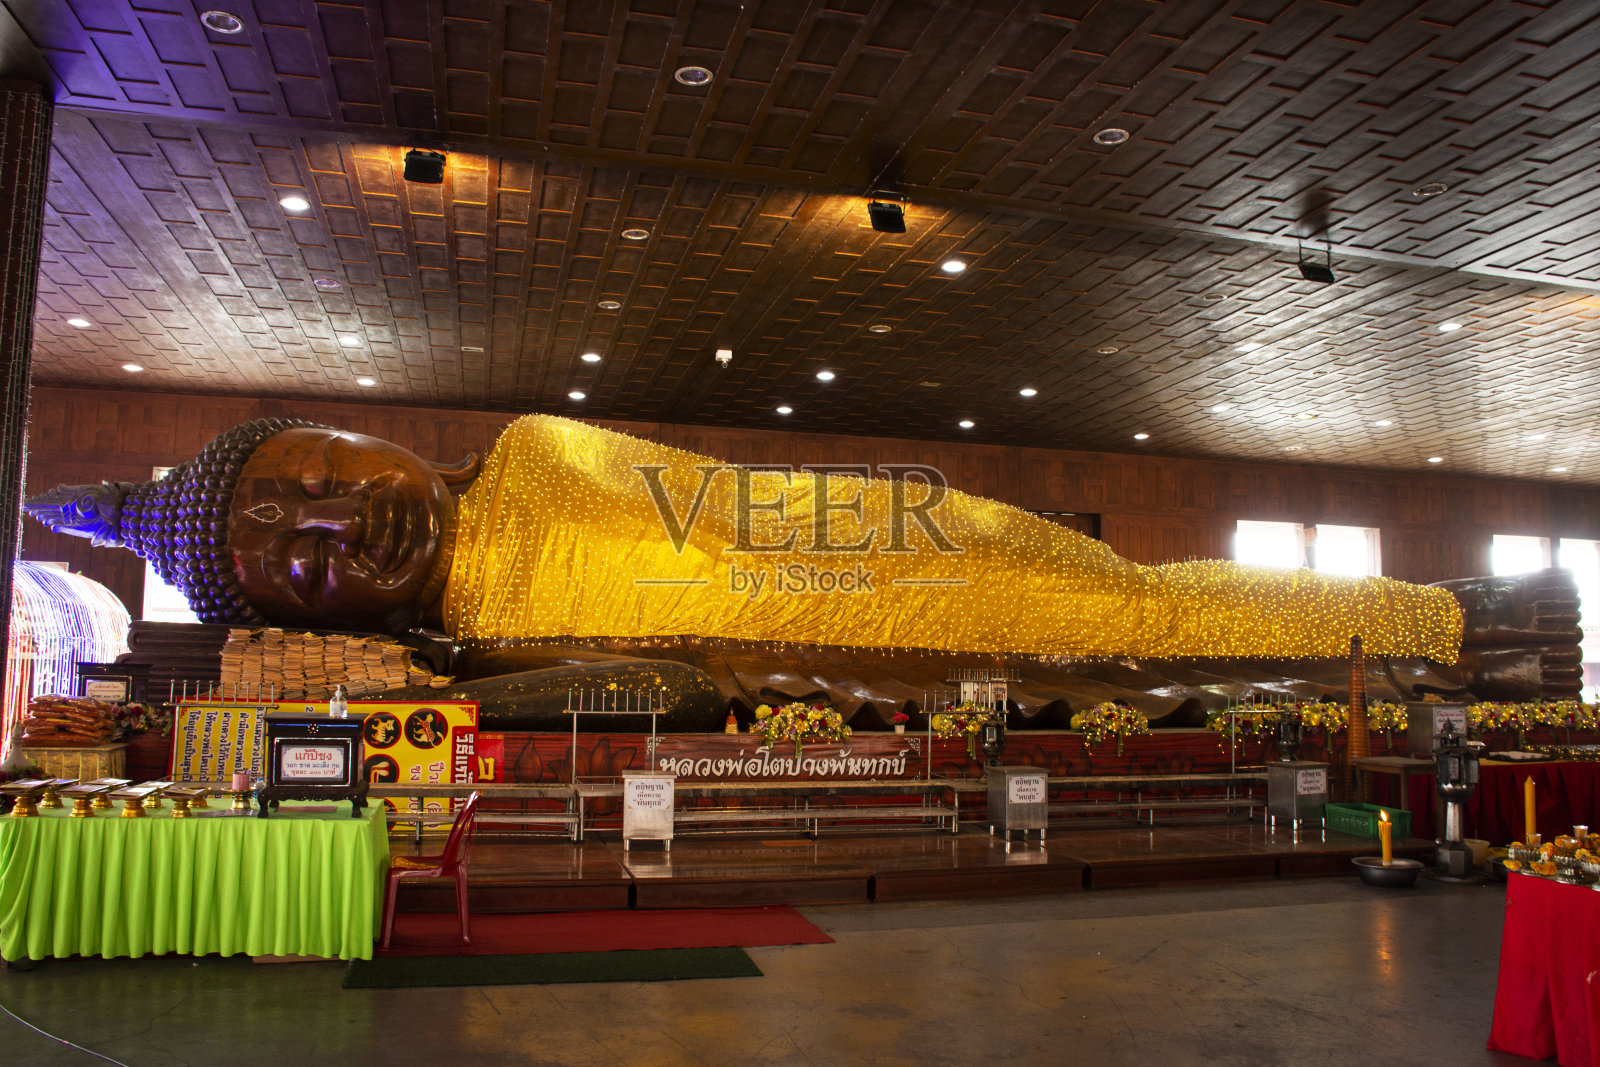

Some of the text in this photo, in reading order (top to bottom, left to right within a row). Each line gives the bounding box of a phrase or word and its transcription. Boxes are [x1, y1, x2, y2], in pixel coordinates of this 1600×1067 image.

[234, 712, 250, 774] ฝ่ามือหลวงพ่อโ
